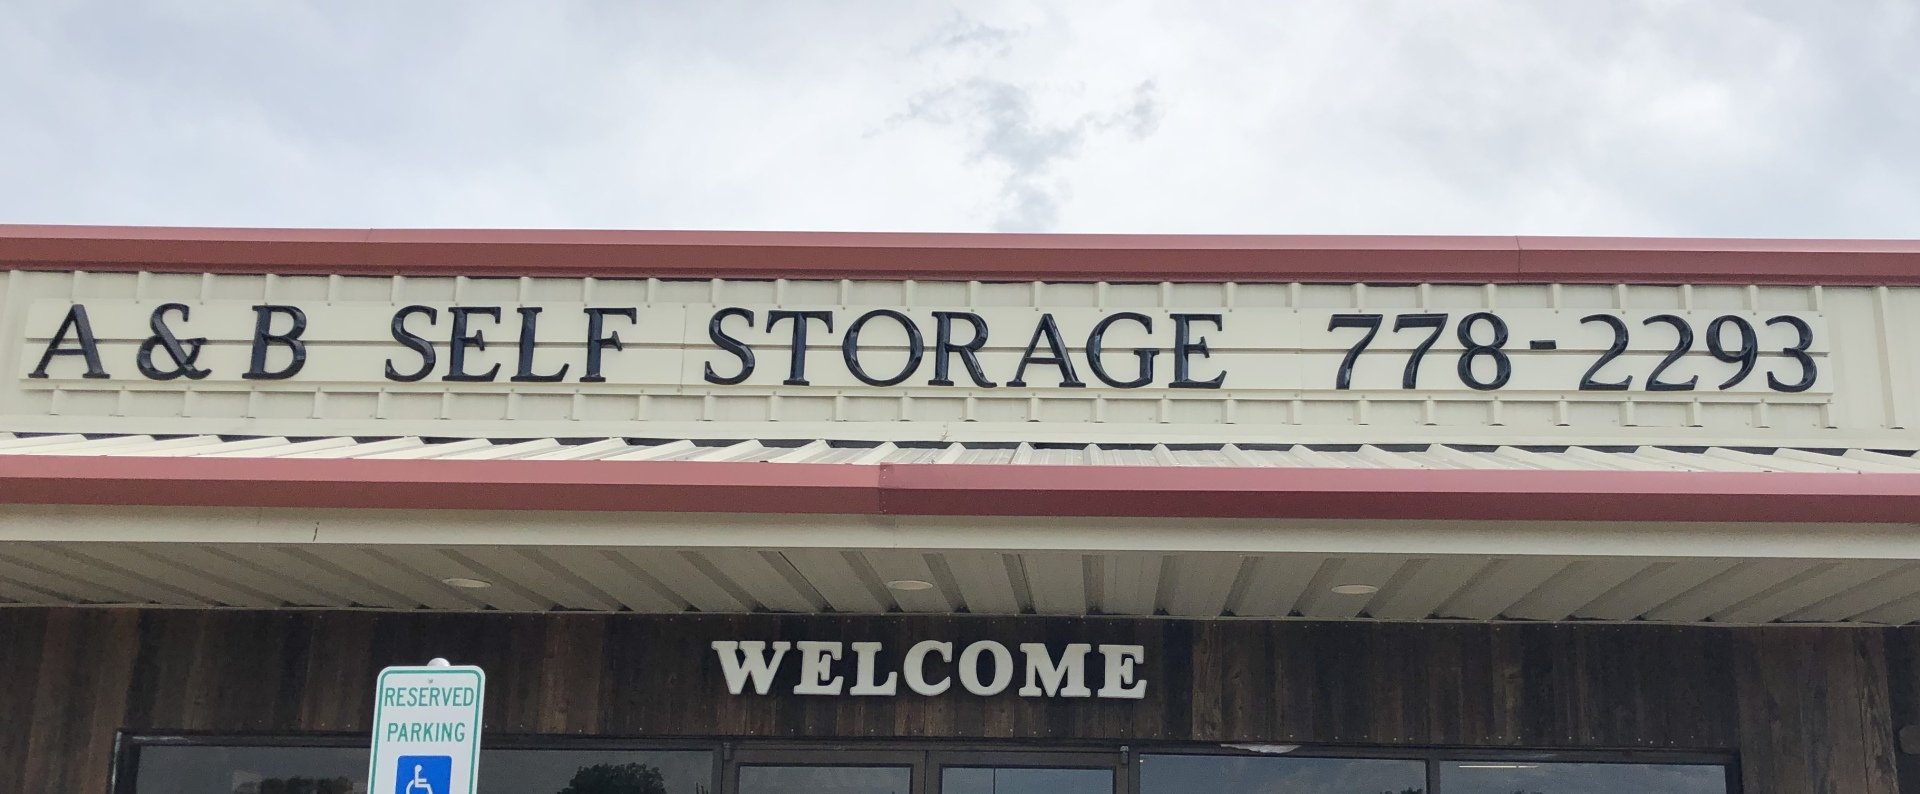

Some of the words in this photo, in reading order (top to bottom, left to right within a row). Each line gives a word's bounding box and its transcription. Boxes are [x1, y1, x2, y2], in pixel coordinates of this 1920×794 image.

[28, 304, 111, 381] A
[136, 302, 213, 382] &
[241, 304, 310, 382] B
[384, 304, 638, 384] SELF
[703, 307, 1228, 391] STORAGE
[1327, 311, 1818, 394] 778-2293
[711, 639, 1148, 699] WELCOME
[384, 687, 474, 707] RESERVED
[387, 722, 466, 742] PARKING
